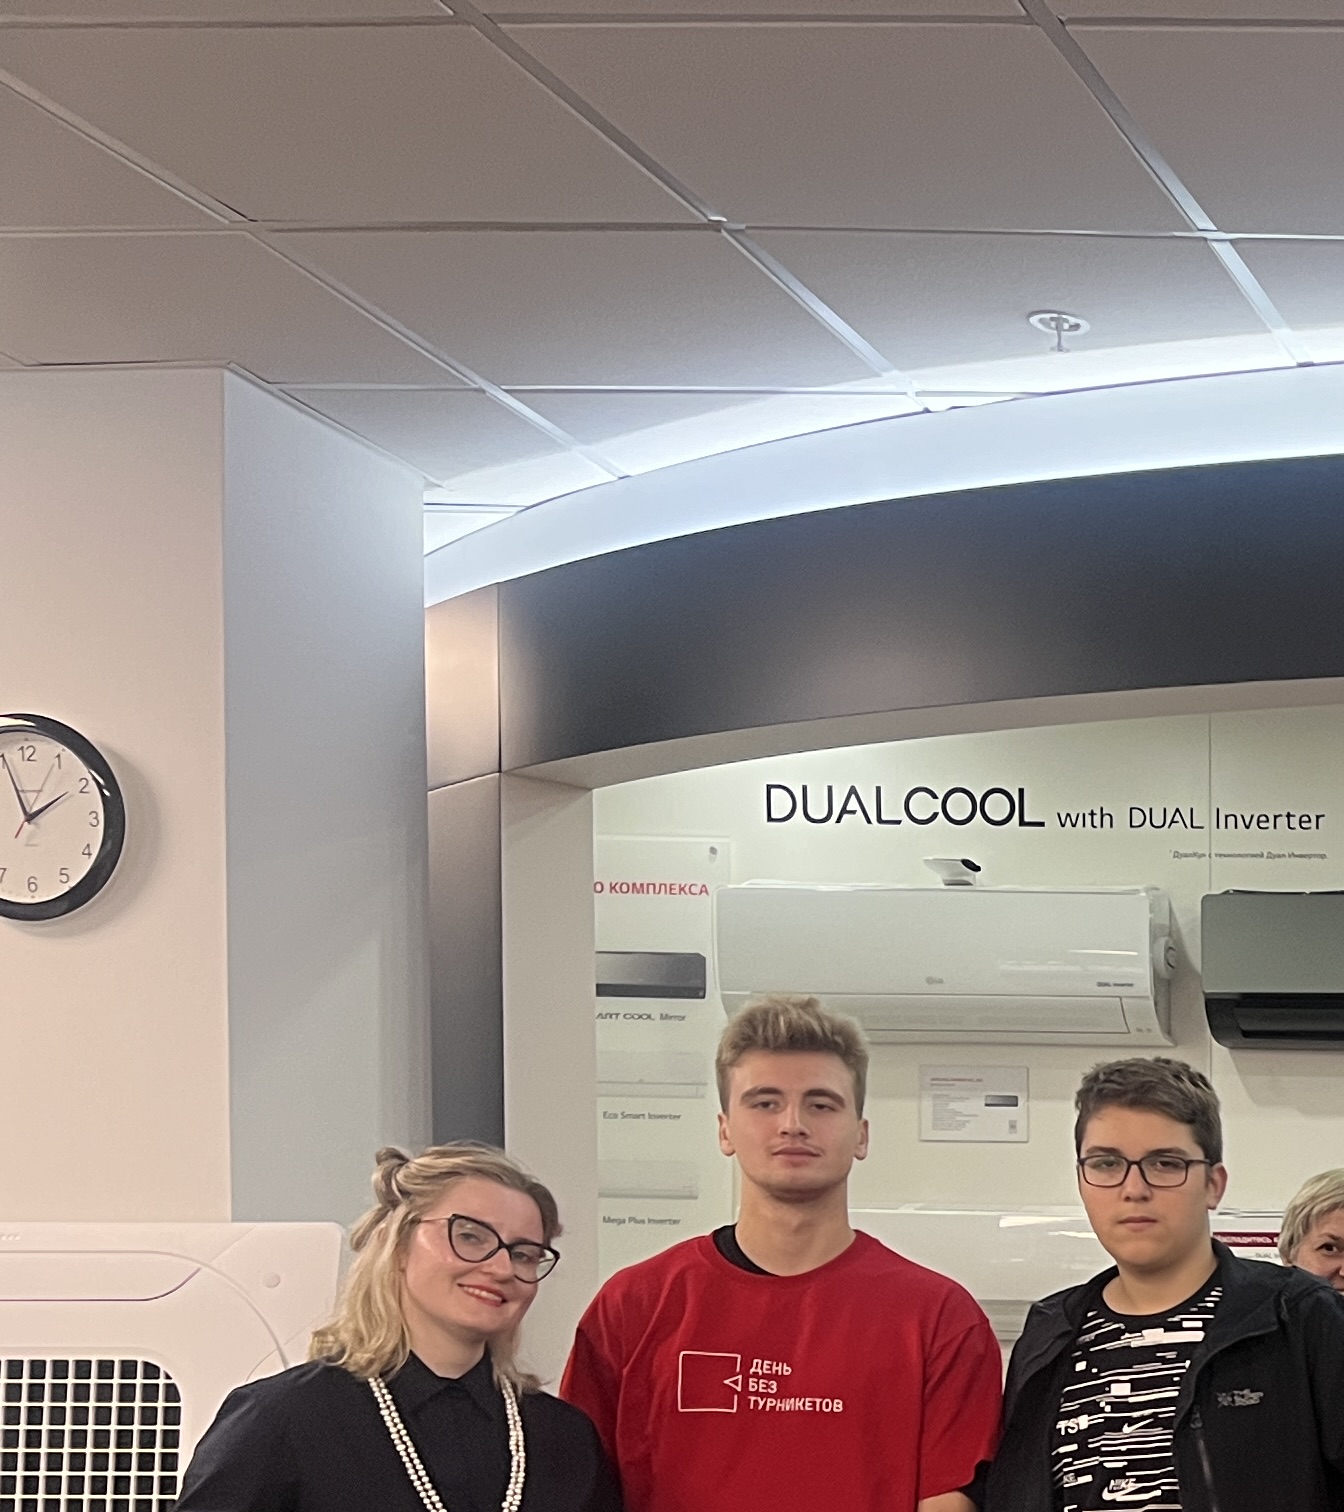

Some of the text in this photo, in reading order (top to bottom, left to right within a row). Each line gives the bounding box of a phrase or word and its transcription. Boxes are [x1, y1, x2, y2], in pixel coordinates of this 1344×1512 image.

[18, 745, 37, 762] 12
[54, 753, 61, 770] 1
[78, 777, 90, 794] 2
[766, 784, 1326, 831] DUALCOOL with DUAL Inverter
[88, 810, 100, 828] 3
[81, 843, 92, 859] 4
[27, 876, 38, 893] 6
[59, 868, 70, 884] 5
[609, 881, 710, 896] КОМПЛЕКСА
[750, 1358, 792, 1376] ДЕНЬ
[748, 1377, 778, 1394] БЕЗ
[748, 1396, 843, 1412] ТУРНИКЕТОВ
